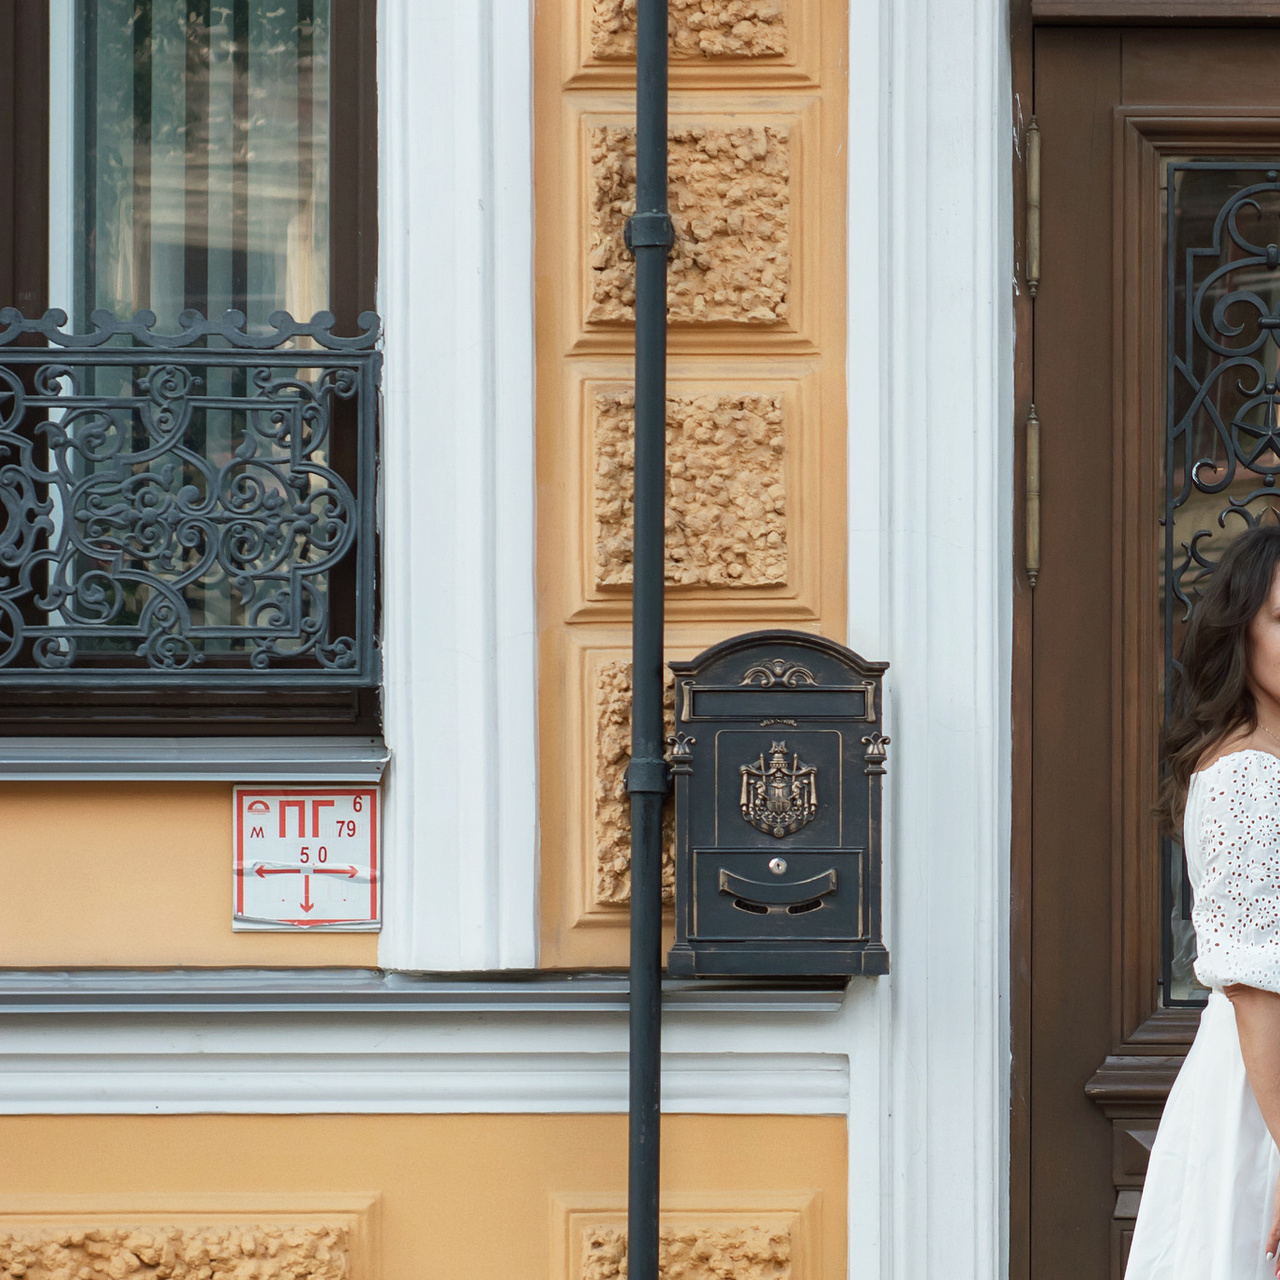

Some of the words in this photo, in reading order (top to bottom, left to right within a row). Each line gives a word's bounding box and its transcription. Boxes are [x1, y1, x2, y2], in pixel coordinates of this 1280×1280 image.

[353, 795, 362, 812] 6
[279, 800, 335, 838] ПГ
[336, 820, 356, 837] 79
